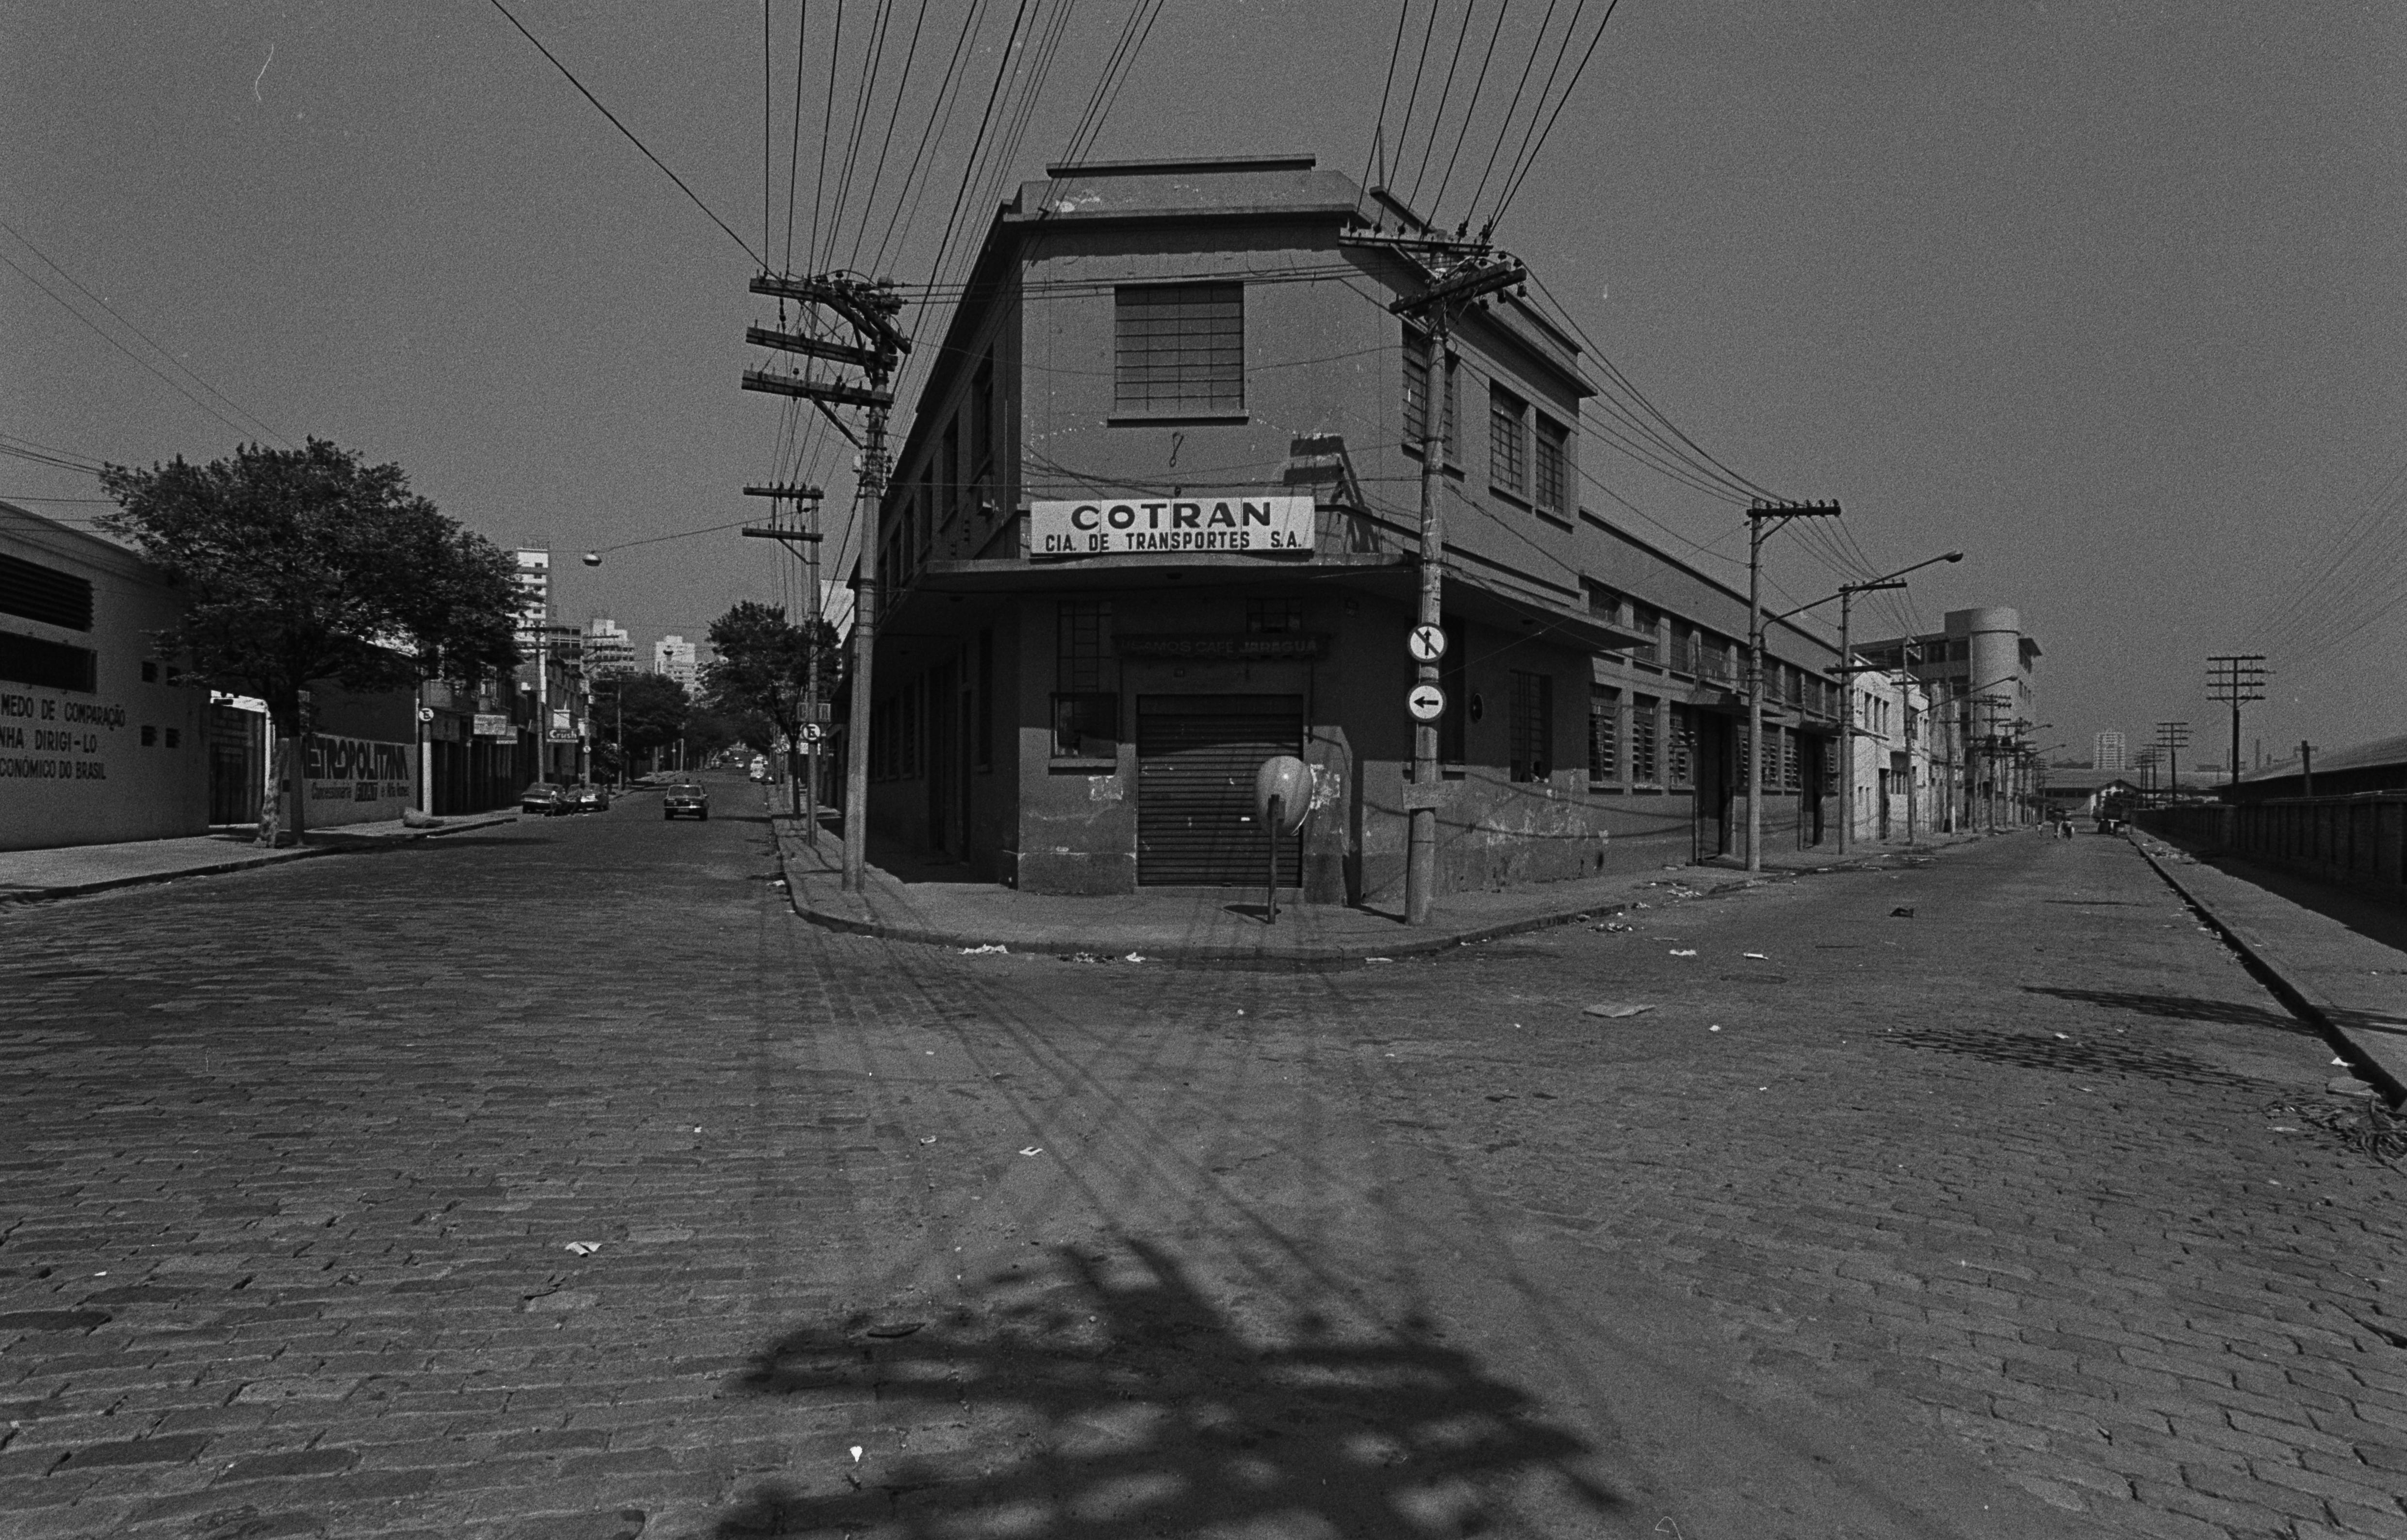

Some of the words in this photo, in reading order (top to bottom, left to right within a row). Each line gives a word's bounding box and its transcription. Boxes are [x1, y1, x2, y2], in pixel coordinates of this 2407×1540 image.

[1071, 501, 1271, 530] COTRAN
[1046, 534, 1077, 552] CIA.
[1088, 532, 1110, 551] DE
[1126, 531, 1250, 550] TRANSPORTES
[1271, 531, 1302, 548] S.A.
[1195, 639, 1234, 653] CAFÉ
[1239, 637, 1318, 653] JARAGUÁ
[1, 693, 33, 718] MEDO
[41, 699, 55, 721] DE
[65, 702, 126, 731] COMPARAÇÃO
[35, 729, 97, 753] DIRIGI-LO
[549, 729, 577, 738] Crush
[59, 760, 72, 779] DO
[76, 761, 106, 780] BRASIL
[356, 782, 378, 801] FIAT
